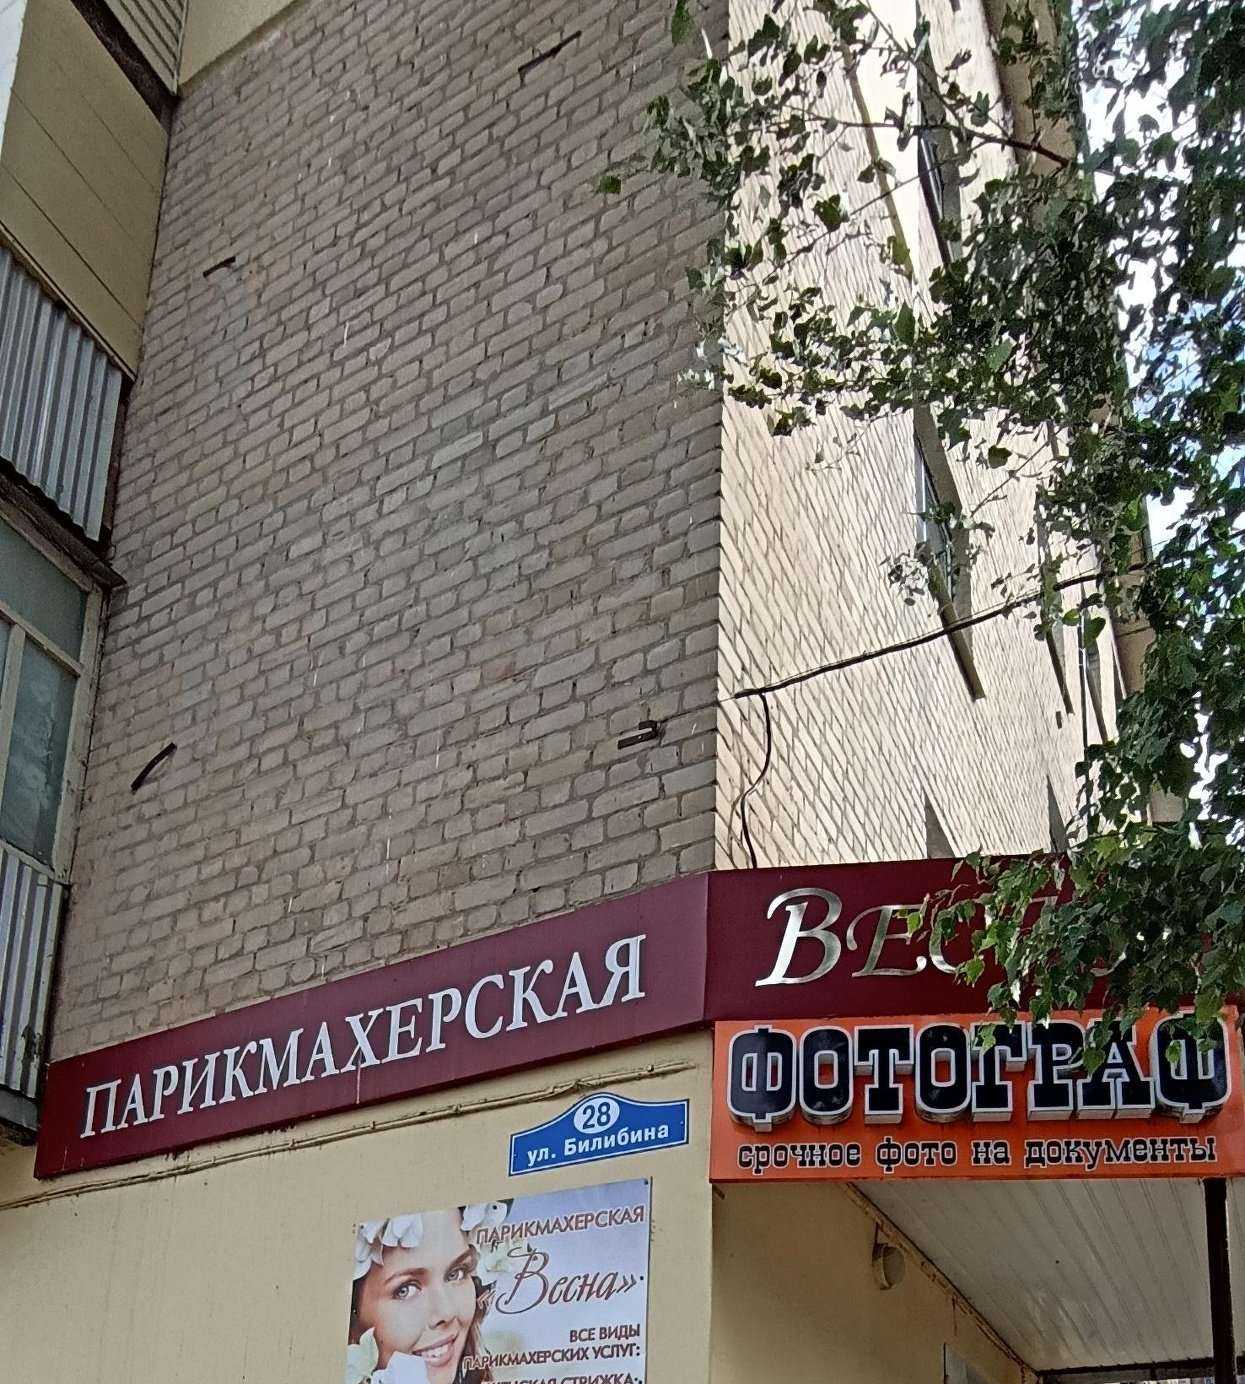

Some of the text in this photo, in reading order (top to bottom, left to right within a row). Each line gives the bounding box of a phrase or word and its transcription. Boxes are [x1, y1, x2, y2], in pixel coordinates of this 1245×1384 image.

[79, 934, 646, 1139] ПАРИКМАХЕРСКАЯ
[726, 1008, 1233, 1133] ФОТОГРАФ
[582, 1101, 611, 1129] 28
[527, 1124, 669, 1167] ул. Билибина
[737, 1136, 1218, 1175] срочное фото на документы
[476, 1205, 645, 1244] ПАРИКМАХЕРСКАЯ
[477, 1246, 637, 1314] «Весна»
[569, 1324, 641, 1343] ВСЕ ВИДЫ
[463, 1343, 640, 1369] ПАРИКМАХЕРСКИХ УСЛУГ:
